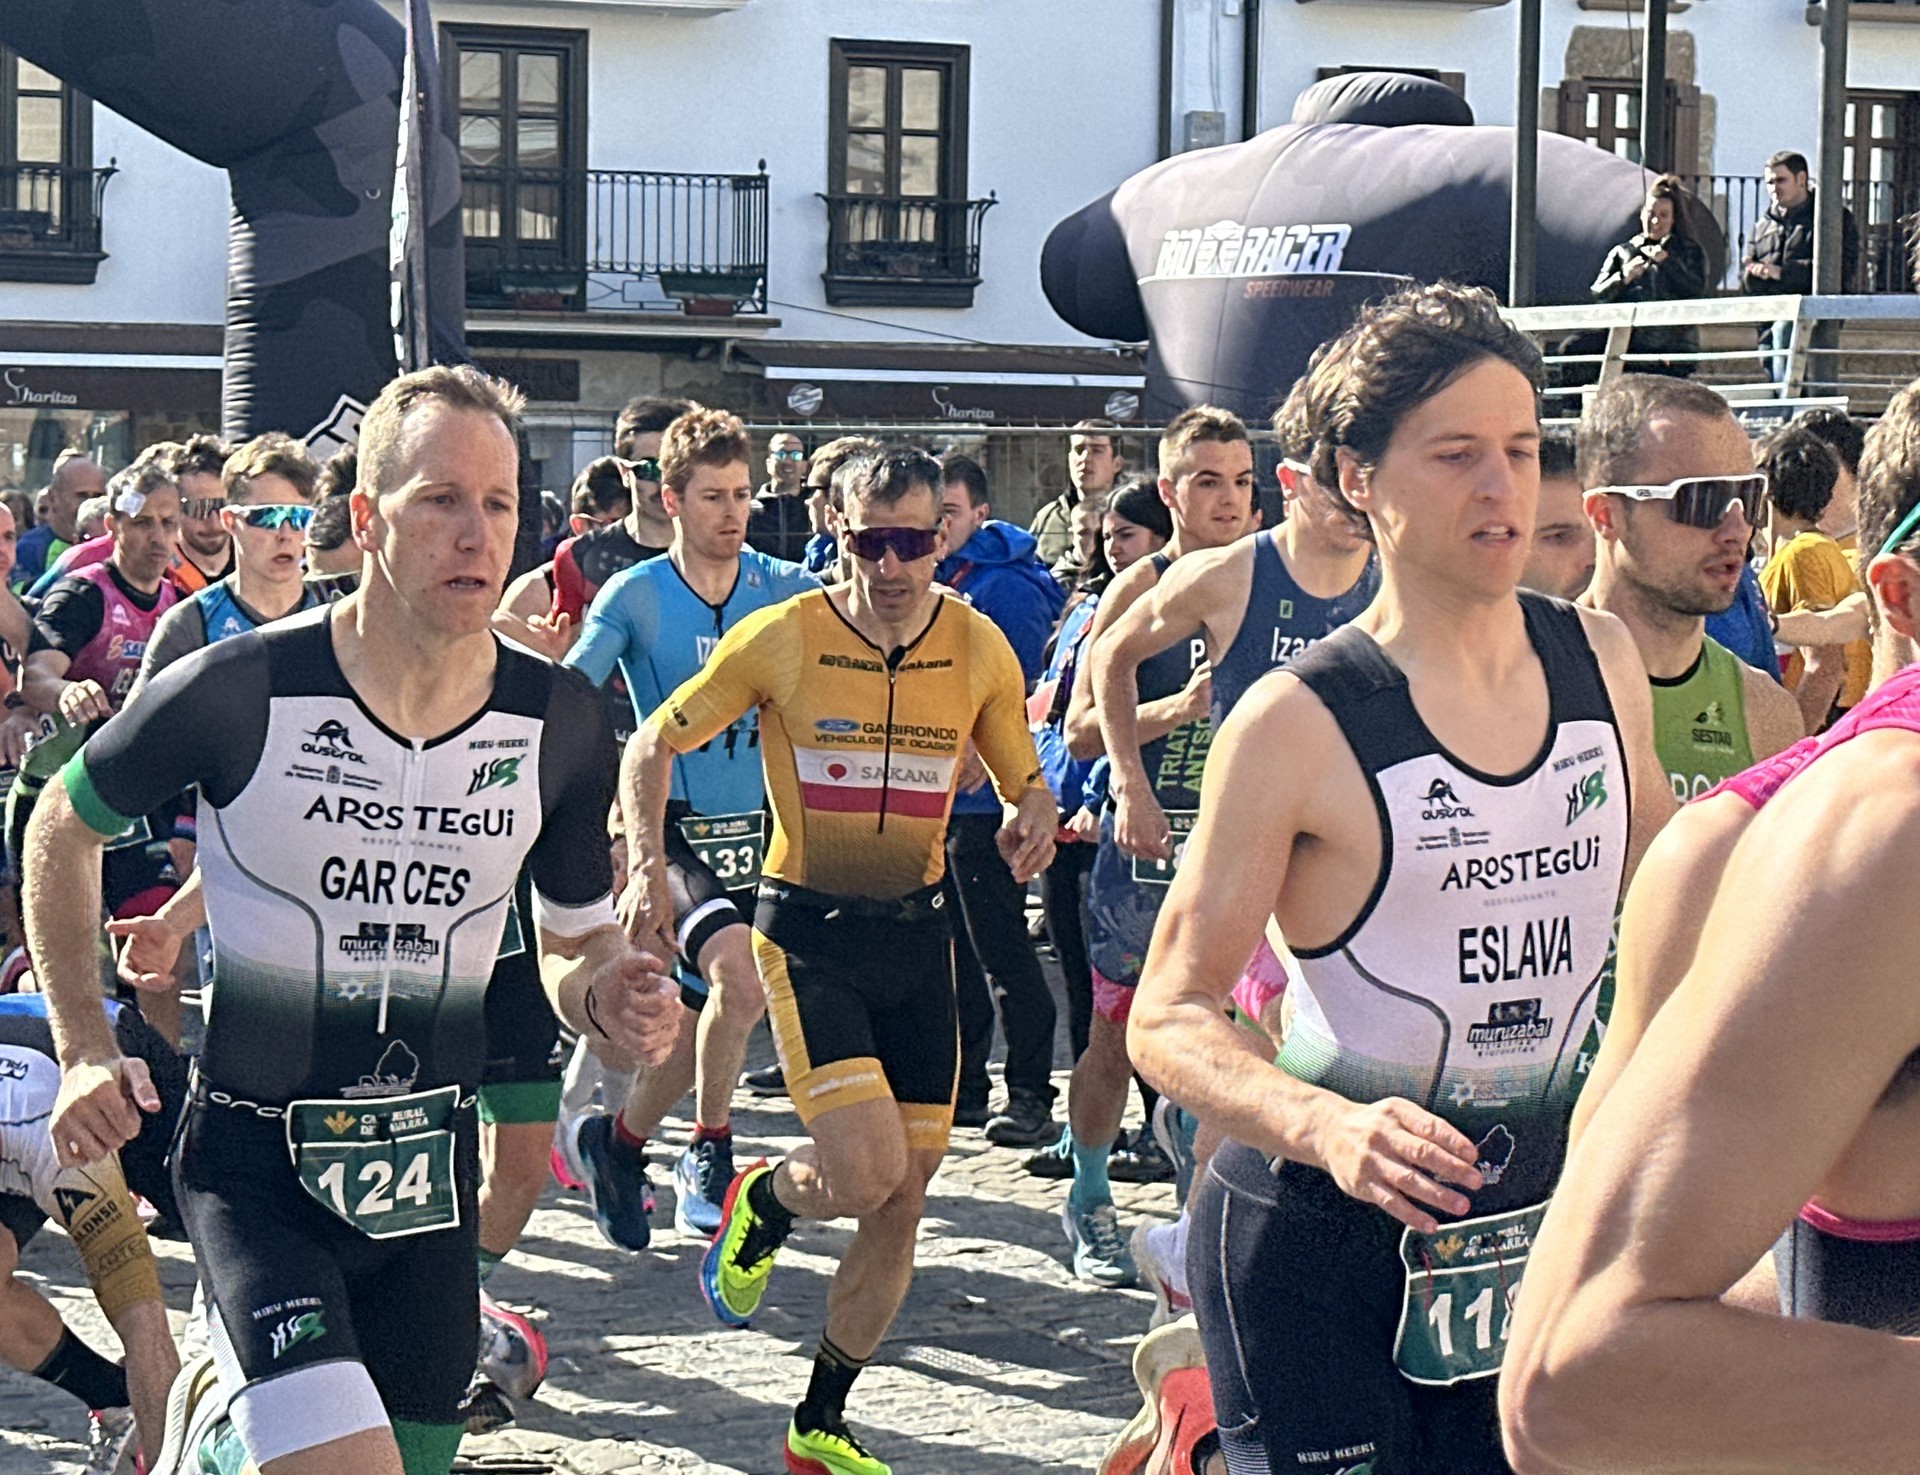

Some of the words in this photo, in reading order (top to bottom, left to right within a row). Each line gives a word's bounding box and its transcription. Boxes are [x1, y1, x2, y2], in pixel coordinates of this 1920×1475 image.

[1244, 279, 1335, 299] SPEEDWEAR
[1271, 626, 1318, 663] Iza
[862, 722, 958, 741] GABIRONDO
[860, 765, 940, 785] SAKANA
[320, 855, 472, 908] GARCES
[1458, 915, 1573, 985] ESLAVA
[317, 1152, 433, 1216] 124
